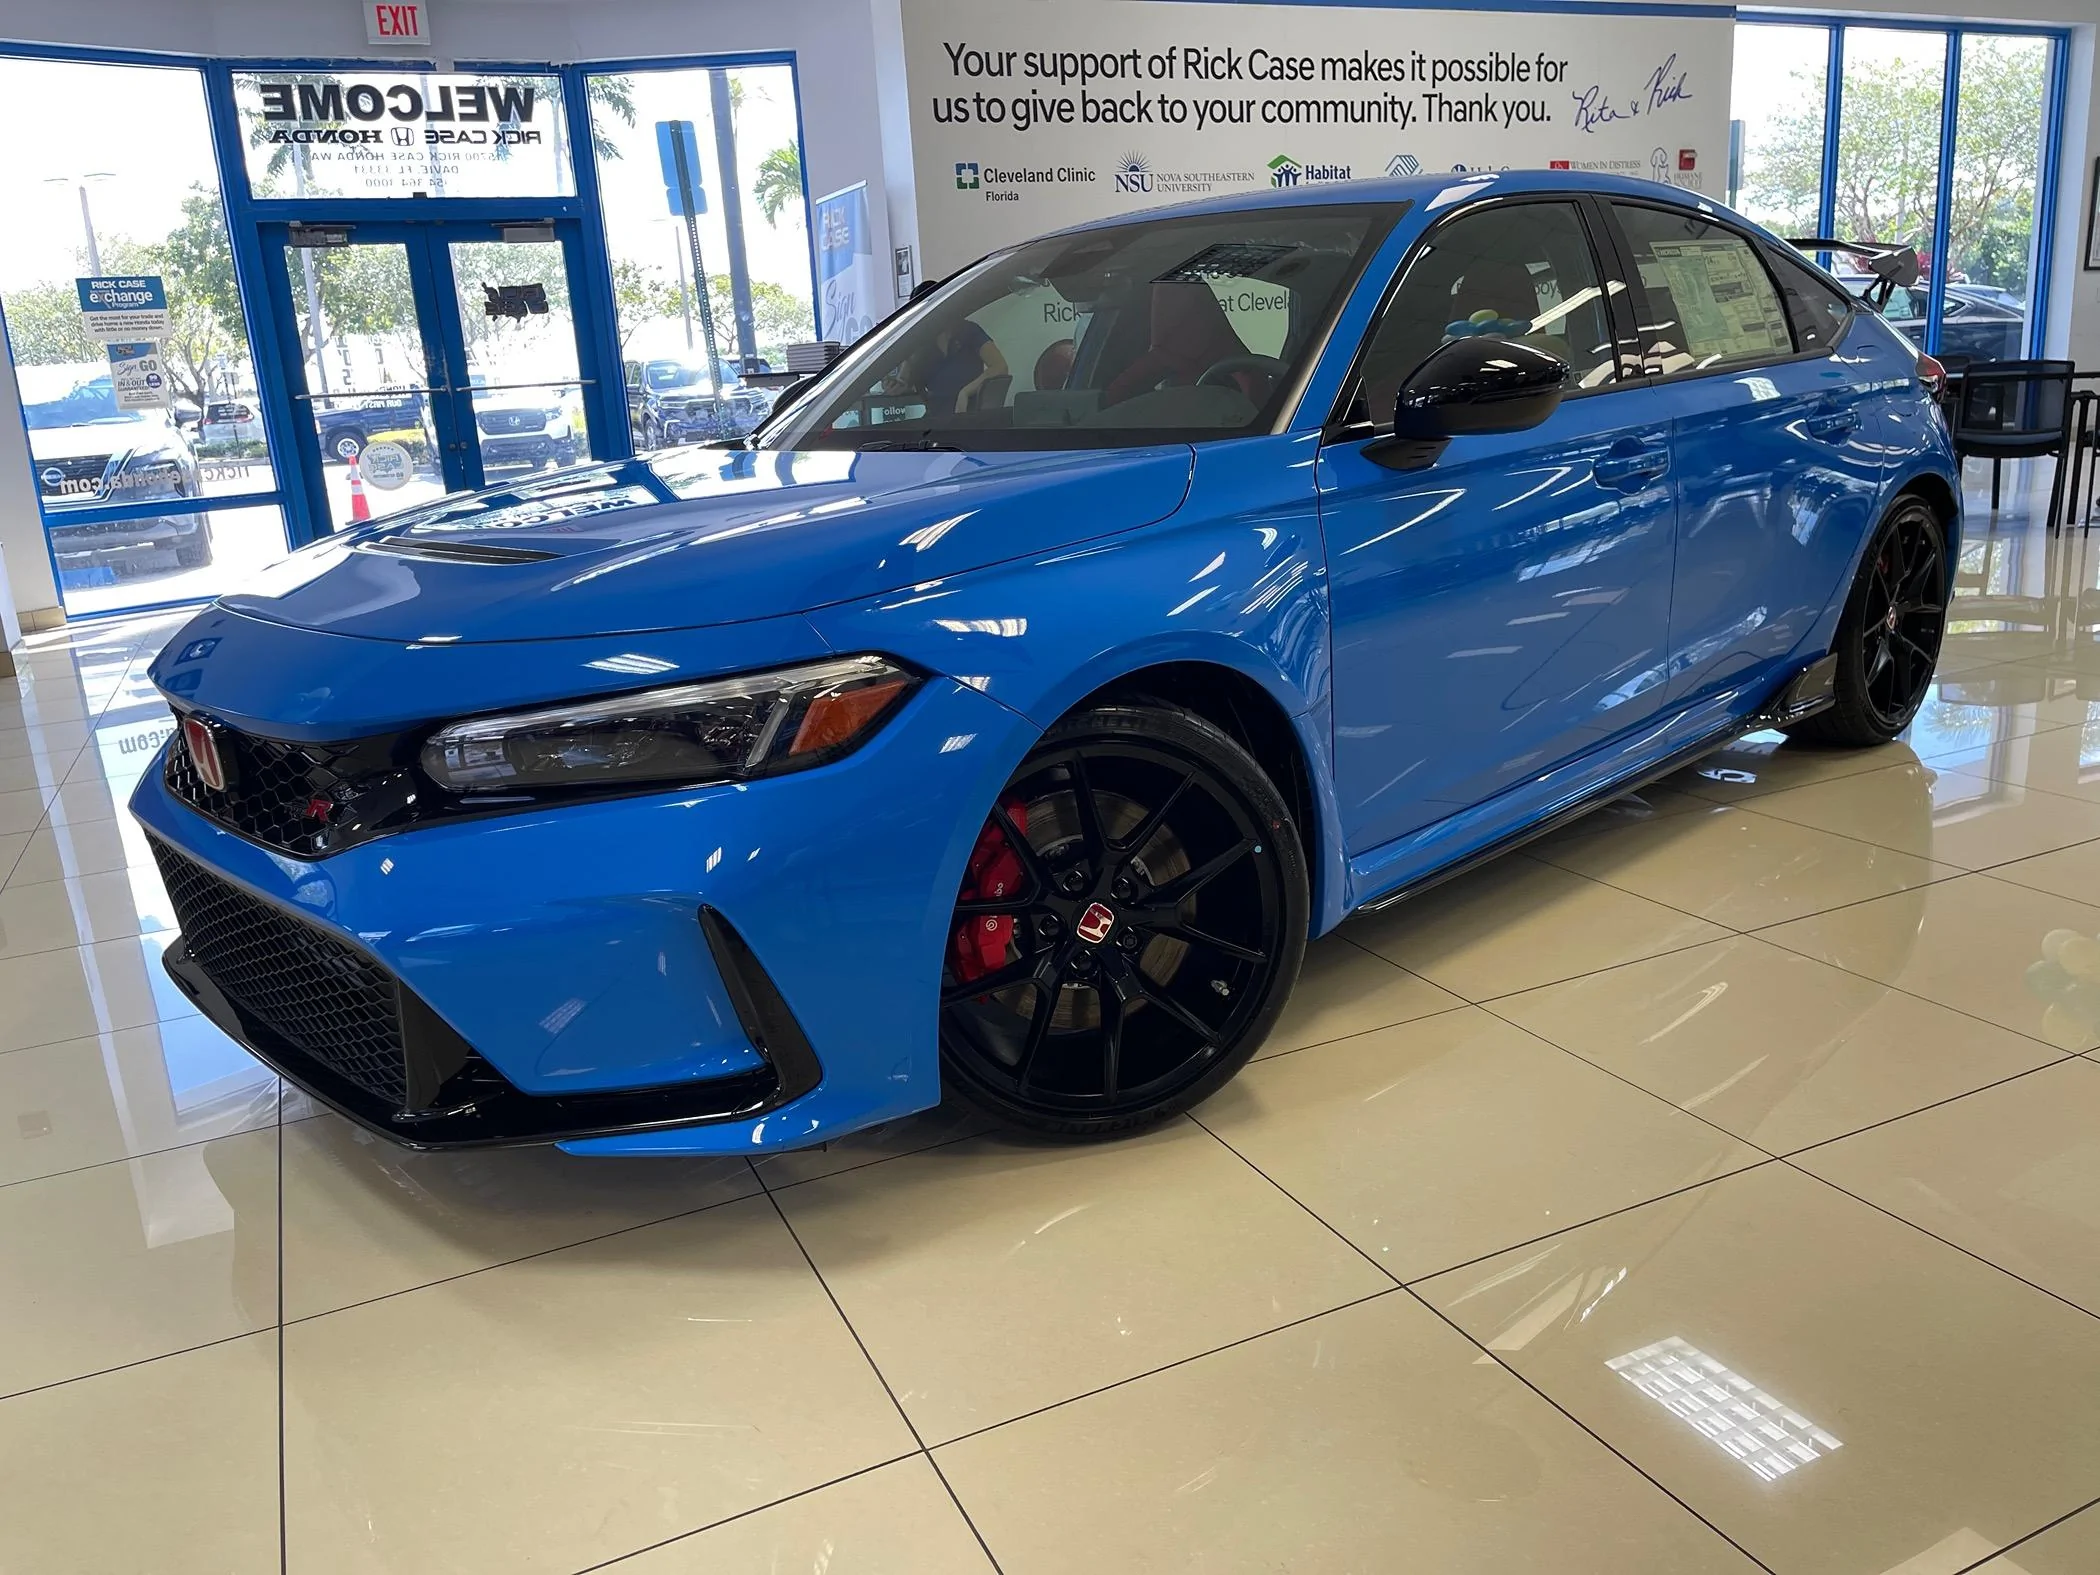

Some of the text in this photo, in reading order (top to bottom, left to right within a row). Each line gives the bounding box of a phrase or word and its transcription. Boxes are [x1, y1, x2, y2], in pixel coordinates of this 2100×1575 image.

[376, 5, 418, 36] EXIT
[943, 42, 1568, 89] Your support of Rick Case makes it possible for
[932, 89, 1551, 131] us to give back to your community. Thank you.
[1572, 85, 1631, 133] Rita
[1305, 165, 1352, 180] Habitat
[1570, 160, 1641, 170] WOMEN IN DISTRESS
[983, 167, 1096, 183] Cleveland Clinic
[1115, 174, 1153, 193] NSU
[1156, 172, 1256, 182] NOVA SOUTHEASTERN
[985, 191, 1019, 201] Florida
[1157, 183, 1213, 192] UNIVERSITY
[822, 207, 846, 227] RICK
[91, 280, 147, 289] RICK CASE
[89, 289, 153, 305] exchange
[1237, 291, 1290, 312] Clevel
[824, 279, 855, 341] Sign
[1043, 301, 1080, 323] Rick
[139, 360, 157, 371] GO
[882, 405, 906, 417] ollow
[306, 798, 334, 823] R
